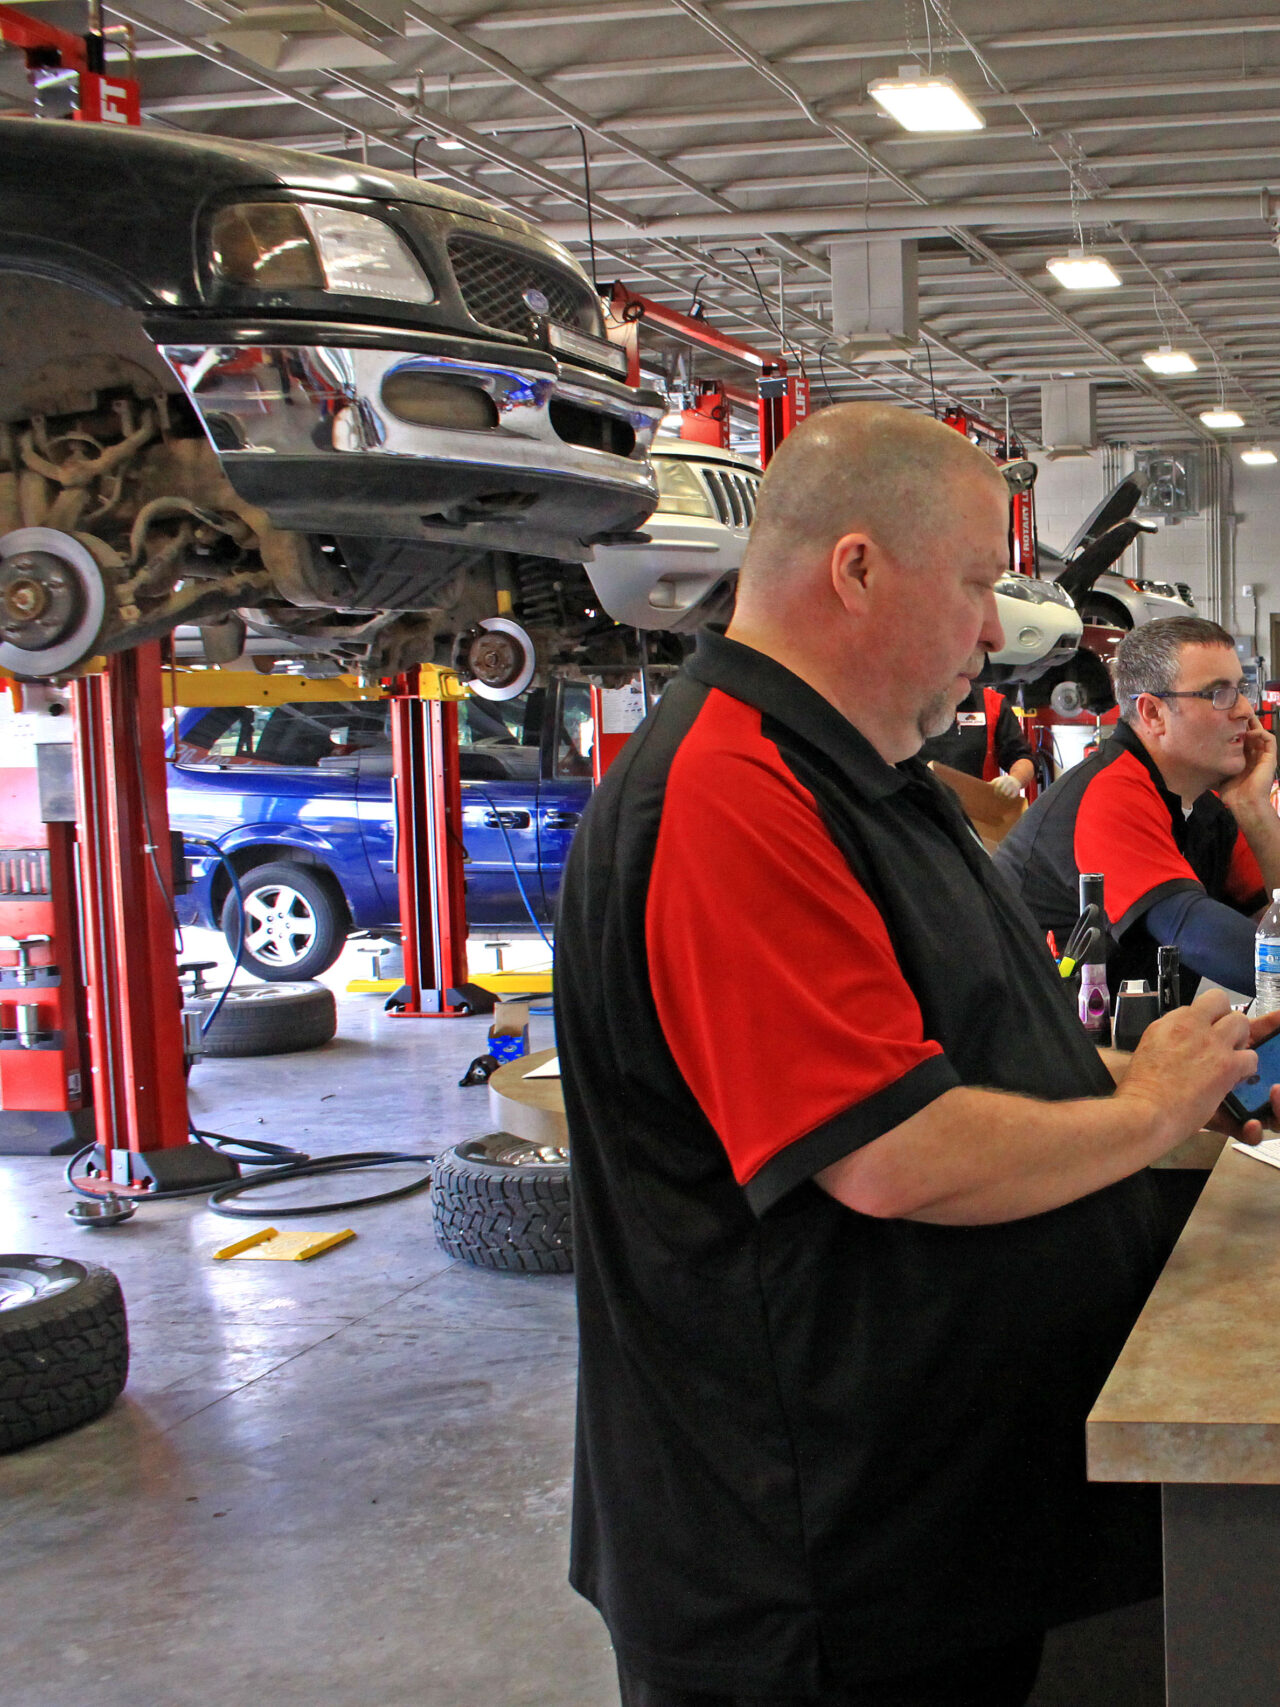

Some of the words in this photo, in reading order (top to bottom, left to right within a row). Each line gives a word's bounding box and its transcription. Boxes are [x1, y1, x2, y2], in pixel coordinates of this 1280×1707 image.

[98, 77, 128, 125] FT
[795, 379, 806, 416] LIFT
[1022, 505, 1030, 552] ROTARY
